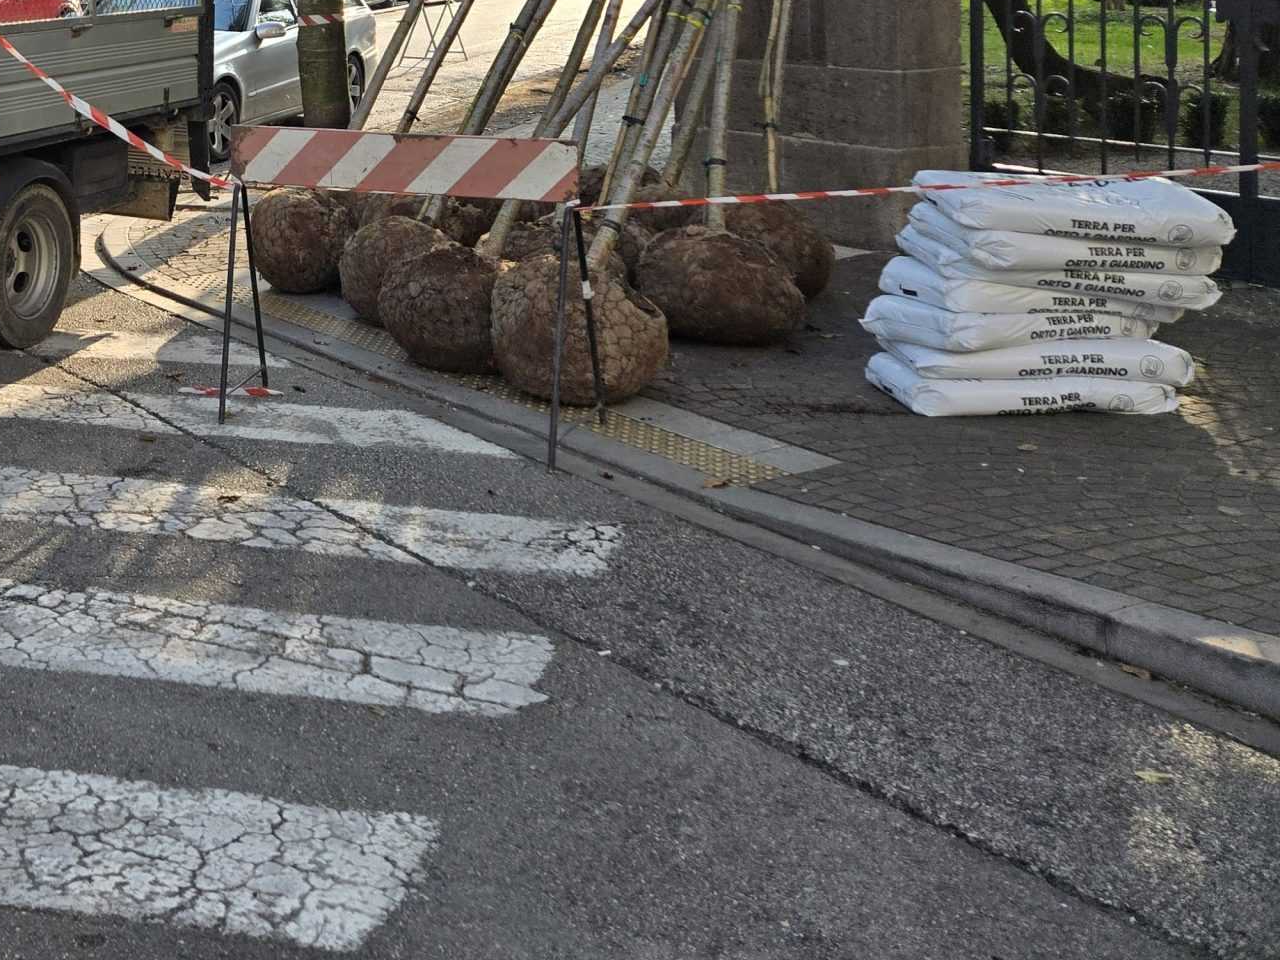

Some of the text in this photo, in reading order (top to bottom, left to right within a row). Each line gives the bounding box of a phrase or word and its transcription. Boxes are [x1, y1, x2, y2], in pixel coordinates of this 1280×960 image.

[1071, 218, 1136, 233] TERRA PER
[1088, 246, 1146, 258] TERRA PER
[1064, 259, 1098, 268] ORTO
[1109, 259, 1165, 270] GIARDINO
[1063, 269, 1126, 285] TERRA PER
[1037, 279, 1146, 297] ORTO E GIARDINO
[1051, 296, 1108, 308] TERRA PER
[1046, 314, 1095, 326] TERRA PER
[1030, 329, 1057, 340] ORTO
[1040, 353, 1105, 366] TERRA PER
[1018, 367, 1053, 377] ORTO
[1066, 366, 1128, 377] GIARDINO
[1021, 392, 1081, 407] TERRA PER
